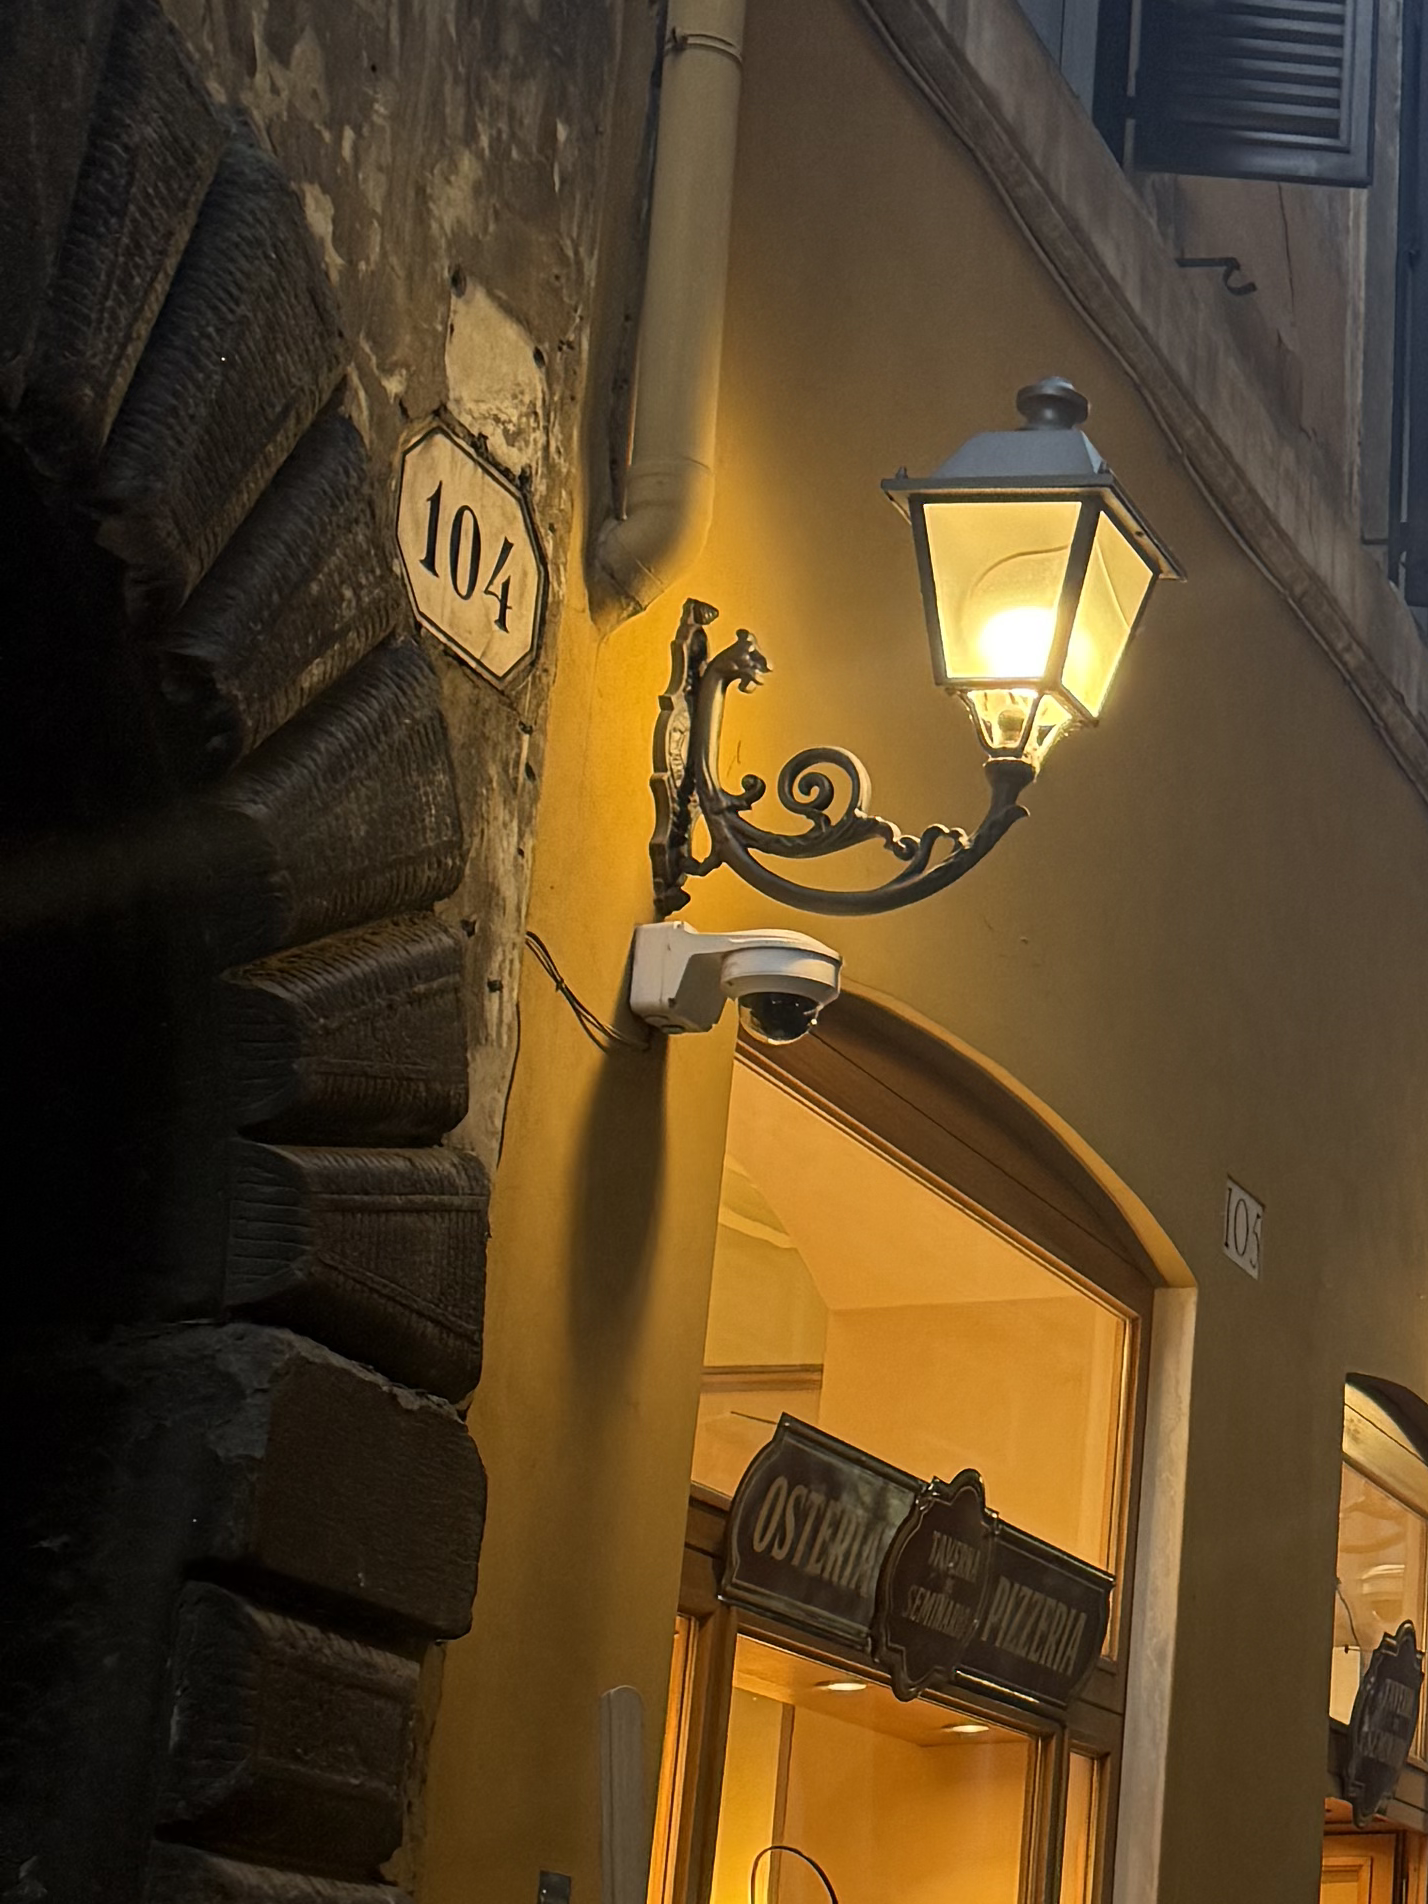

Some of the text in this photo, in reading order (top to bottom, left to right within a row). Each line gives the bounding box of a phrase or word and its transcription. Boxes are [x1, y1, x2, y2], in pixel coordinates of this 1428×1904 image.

[419, 479, 514, 635] 104
[1224, 1187, 1261, 1269] 105
[753, 1476, 884, 1597] OSTERIA
[982, 1575, 1087, 1677] PIZZERIA
